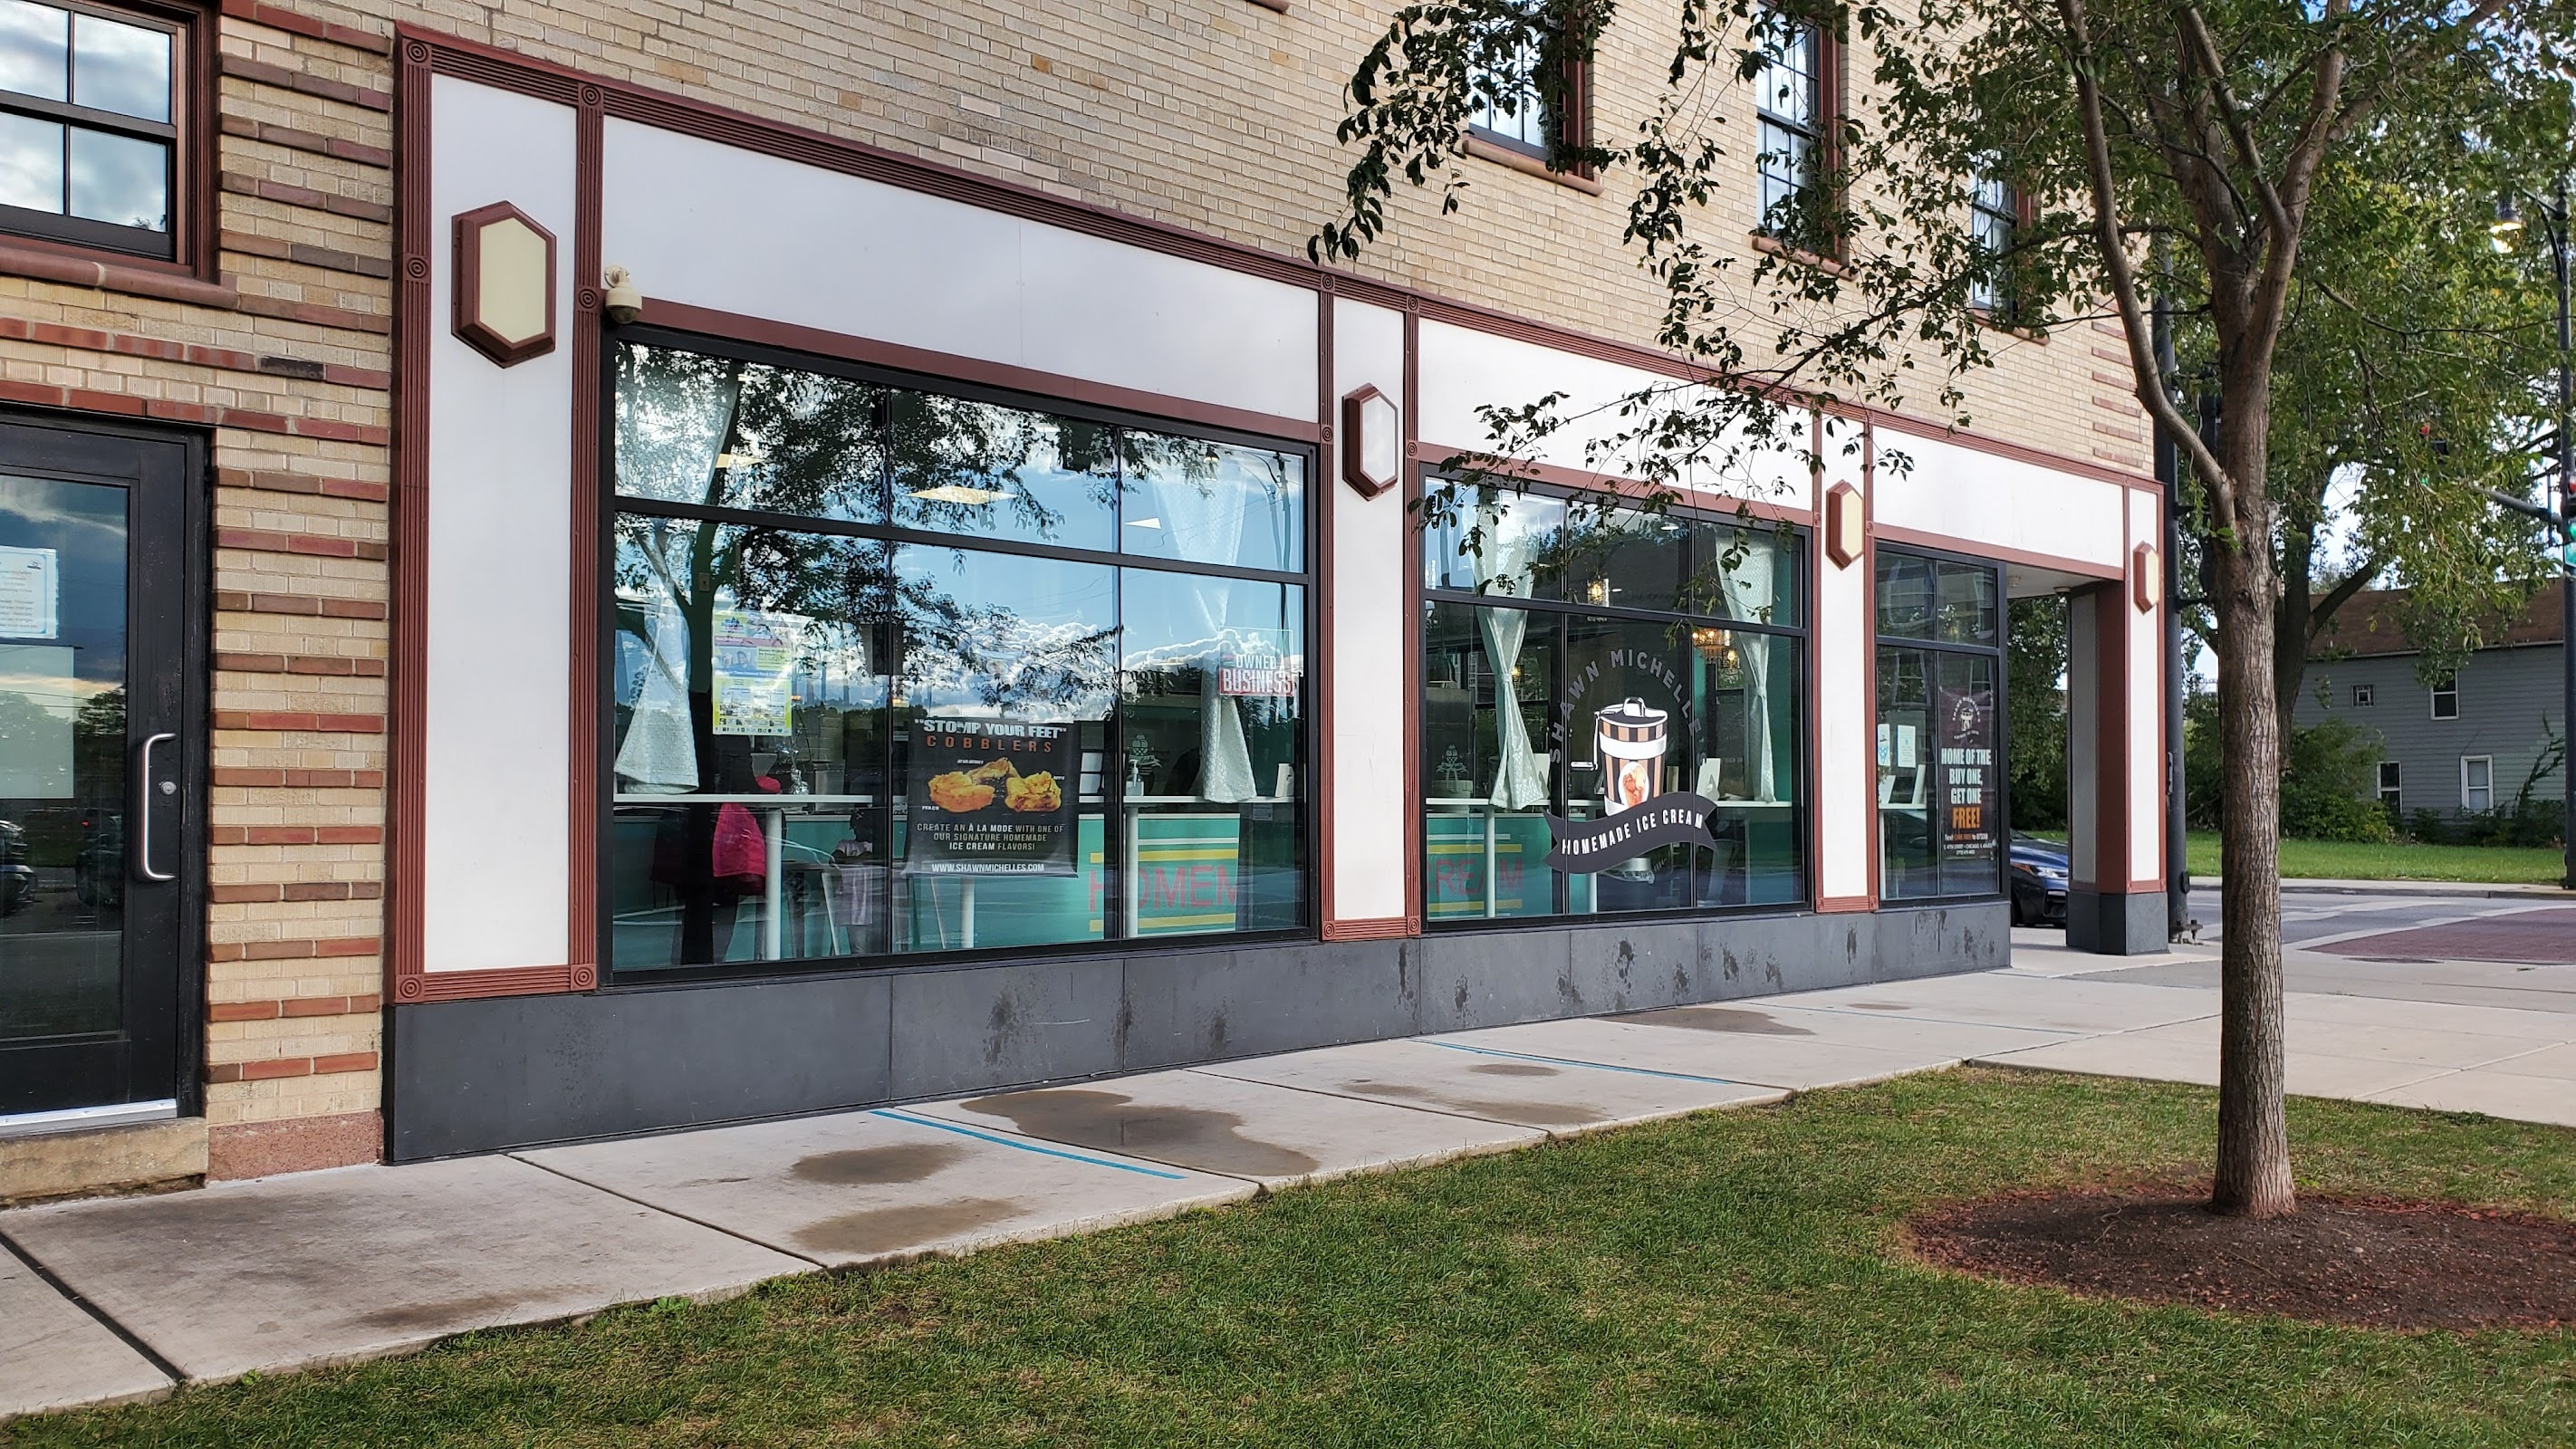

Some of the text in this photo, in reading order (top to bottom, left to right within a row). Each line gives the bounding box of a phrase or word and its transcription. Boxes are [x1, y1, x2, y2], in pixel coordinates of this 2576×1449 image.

[1235, 655, 1277, 670] OWNED
[1223, 668, 1291, 694] BUSINESS
[1550, 660, 1600, 764] SHAWN
[985, 724, 1025, 737] YOUR
[927, 735, 1052, 753] COBBLERS
[1941, 748, 1992, 766] HOME OF THE
[1948, 768, 1983, 786] BUY ONE,
[1950, 787, 1982, 804] GET ONE
[1952, 807, 1981, 829] FREE!
[917, 823, 950, 832] CREATE
[954, 823, 966, 832] AN
[976, 824, 987, 832] LA
[990, 824, 1014, 832] MODE
[1015, 825, 1035, 833] WITH
[1037, 825, 1052, 833] ONE
[1054, 825, 1064, 833] OF
[1562, 809, 1703, 855] HOMEMADE ICE CREAM
[933, 832, 1047, 842] OUR SIGNATURE HOMEMADE
[949, 842, 1035, 850] ICE CREAM FLAVORS!
[931, 863, 1045, 872] WWW.SHAWNMICHELLES.COM
